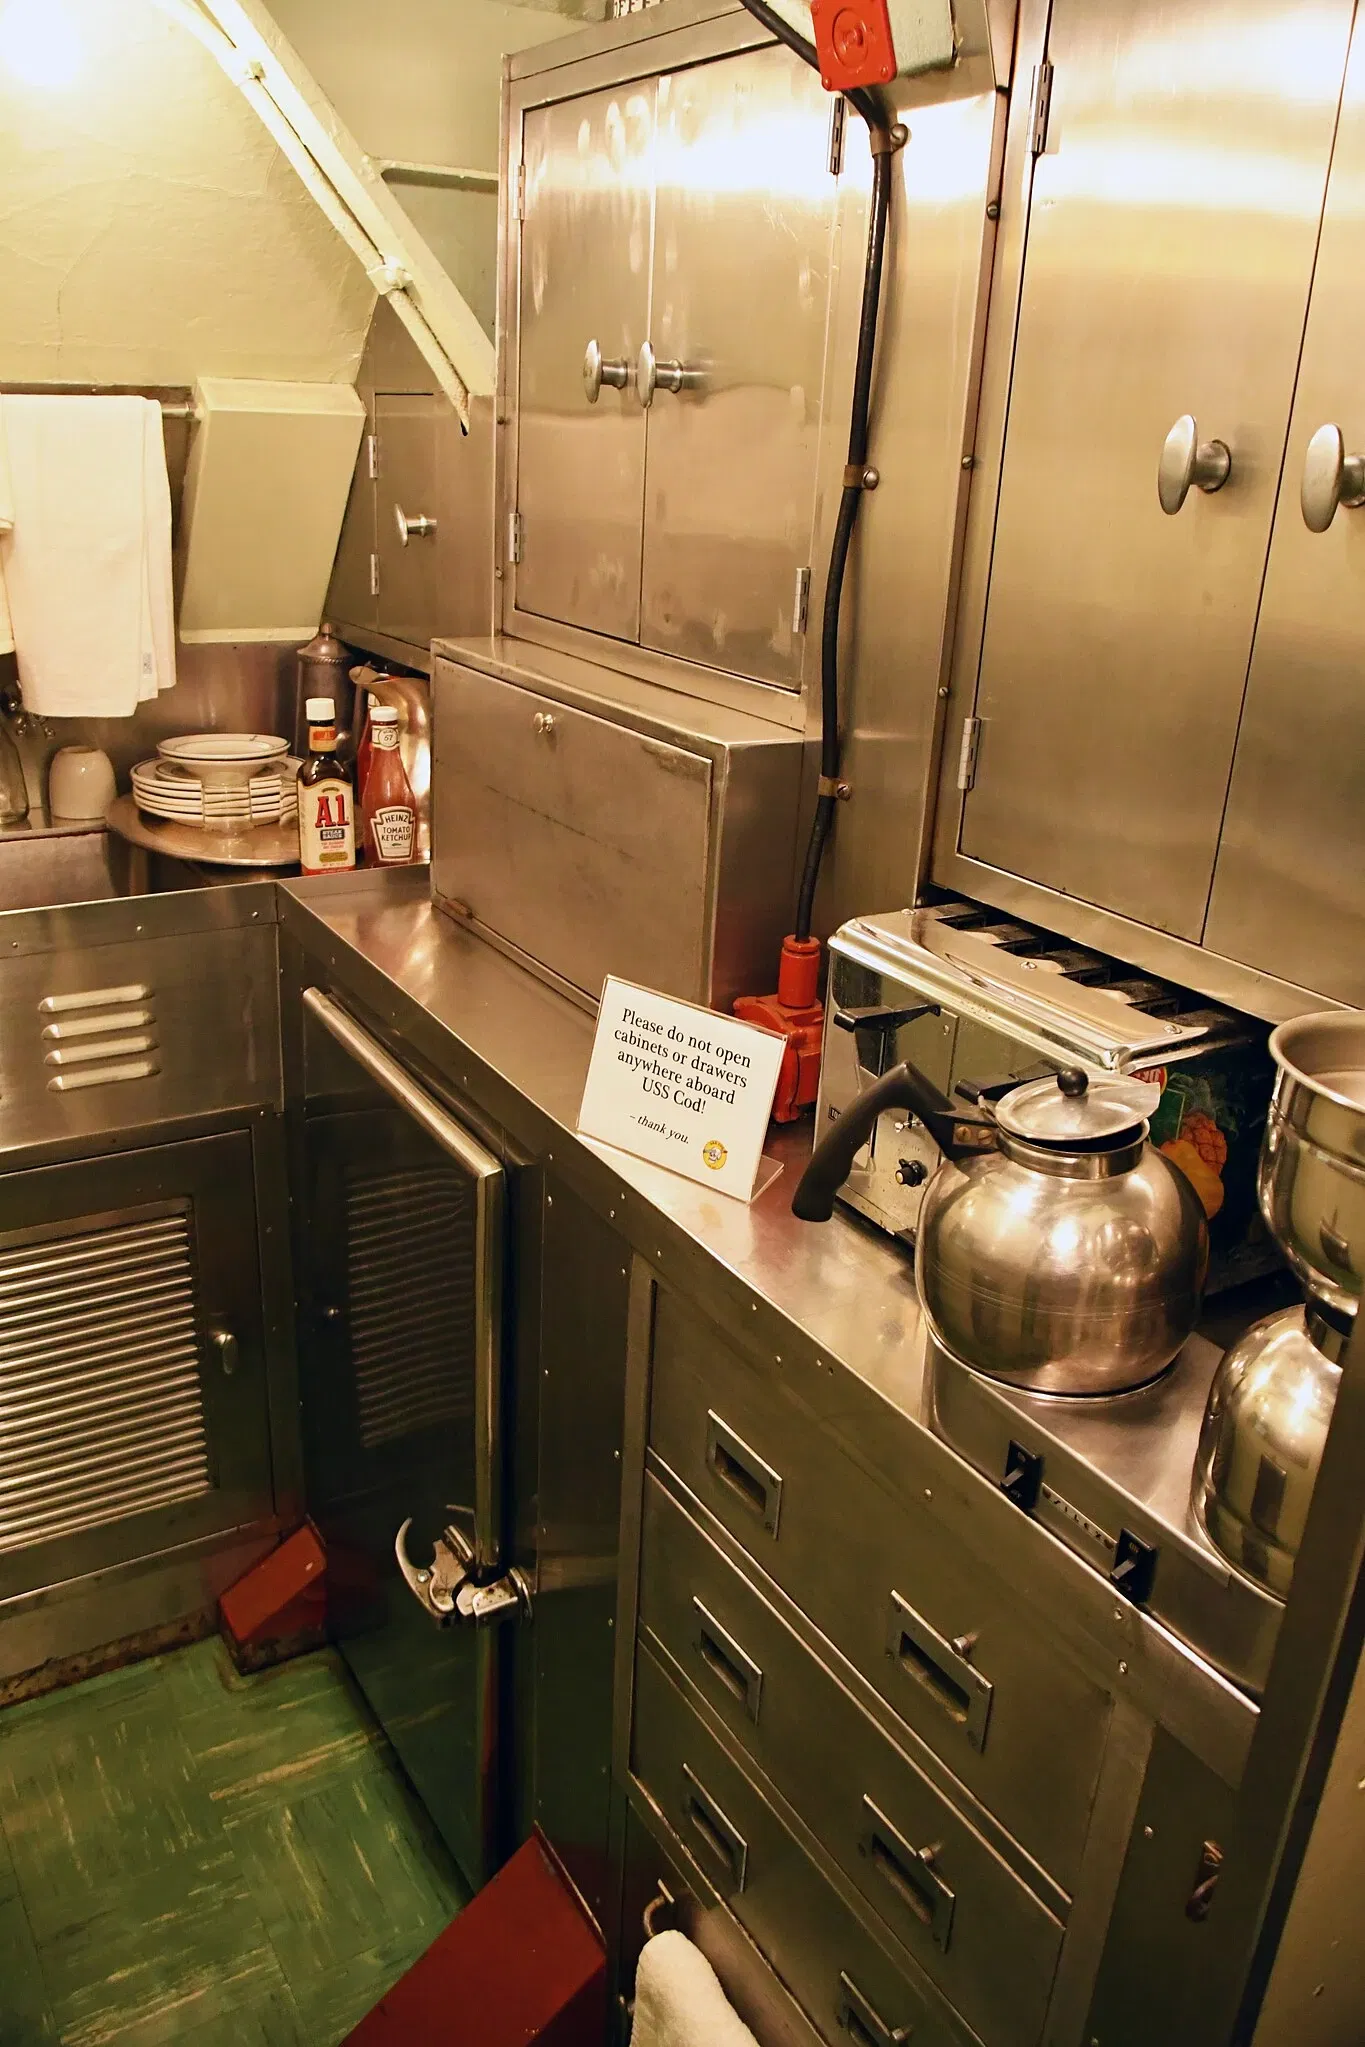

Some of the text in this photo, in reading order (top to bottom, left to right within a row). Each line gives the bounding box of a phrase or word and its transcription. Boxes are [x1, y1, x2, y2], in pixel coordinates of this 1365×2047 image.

[383, 826, 410, 834] TOMATO
[385, 814, 409, 823] HEINZ
[381, 833, 411, 842] KETCHUP
[621, 1008, 751, 1068] Please do not open
[614, 1028, 748, 1088] cabinets or drawers
[617, 1050, 736, 1104] anywhere aboard
[642, 1076, 706, 1114] USS Cod!
[637, 1115, 666, 1135] thank
[666, 1129, 690, 1144] you.
